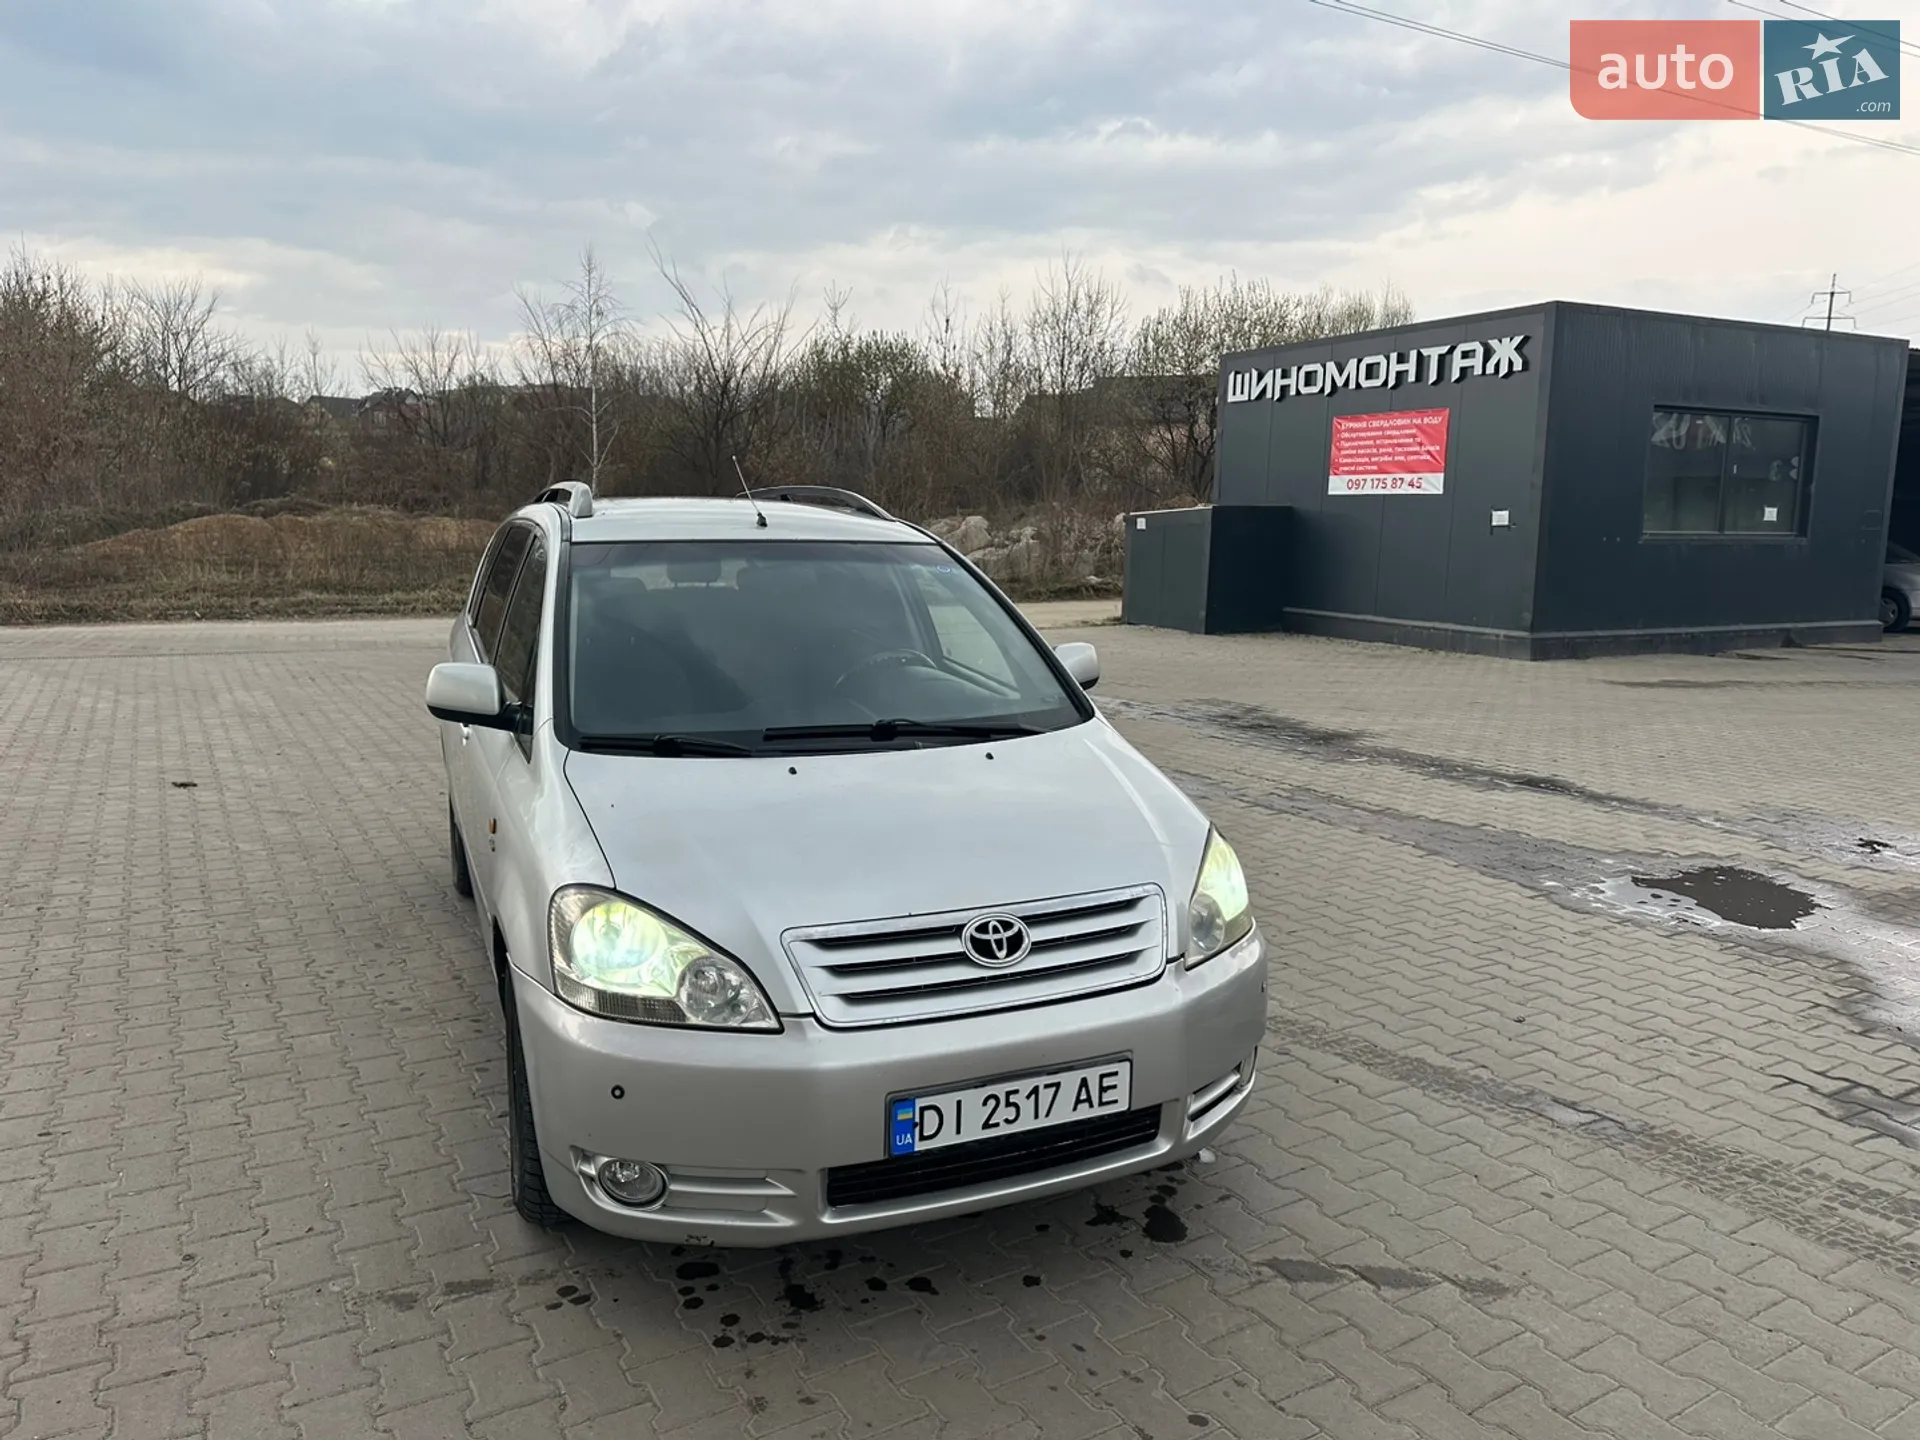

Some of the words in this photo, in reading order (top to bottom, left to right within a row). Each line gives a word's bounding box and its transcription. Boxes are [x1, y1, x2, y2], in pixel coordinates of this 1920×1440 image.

[1227, 334, 1526, 403] ШИНОМОНТАЖ
[1368, 418, 1412, 428] СВЕРДЛОВИН
[1423, 416, 1443, 425] ВОДУ
[1346, 478, 1367, 490] 097
[1370, 477, 1387, 489] 175
[1390, 477, 1404, 489] 87
[1408, 476, 1422, 489] 45
[918, 1099, 962, 1142] DI
[981, 1081, 1062, 1130] 2517
[1072, 1070, 1119, 1112] AE
[896, 1134, 913, 1146] UA
